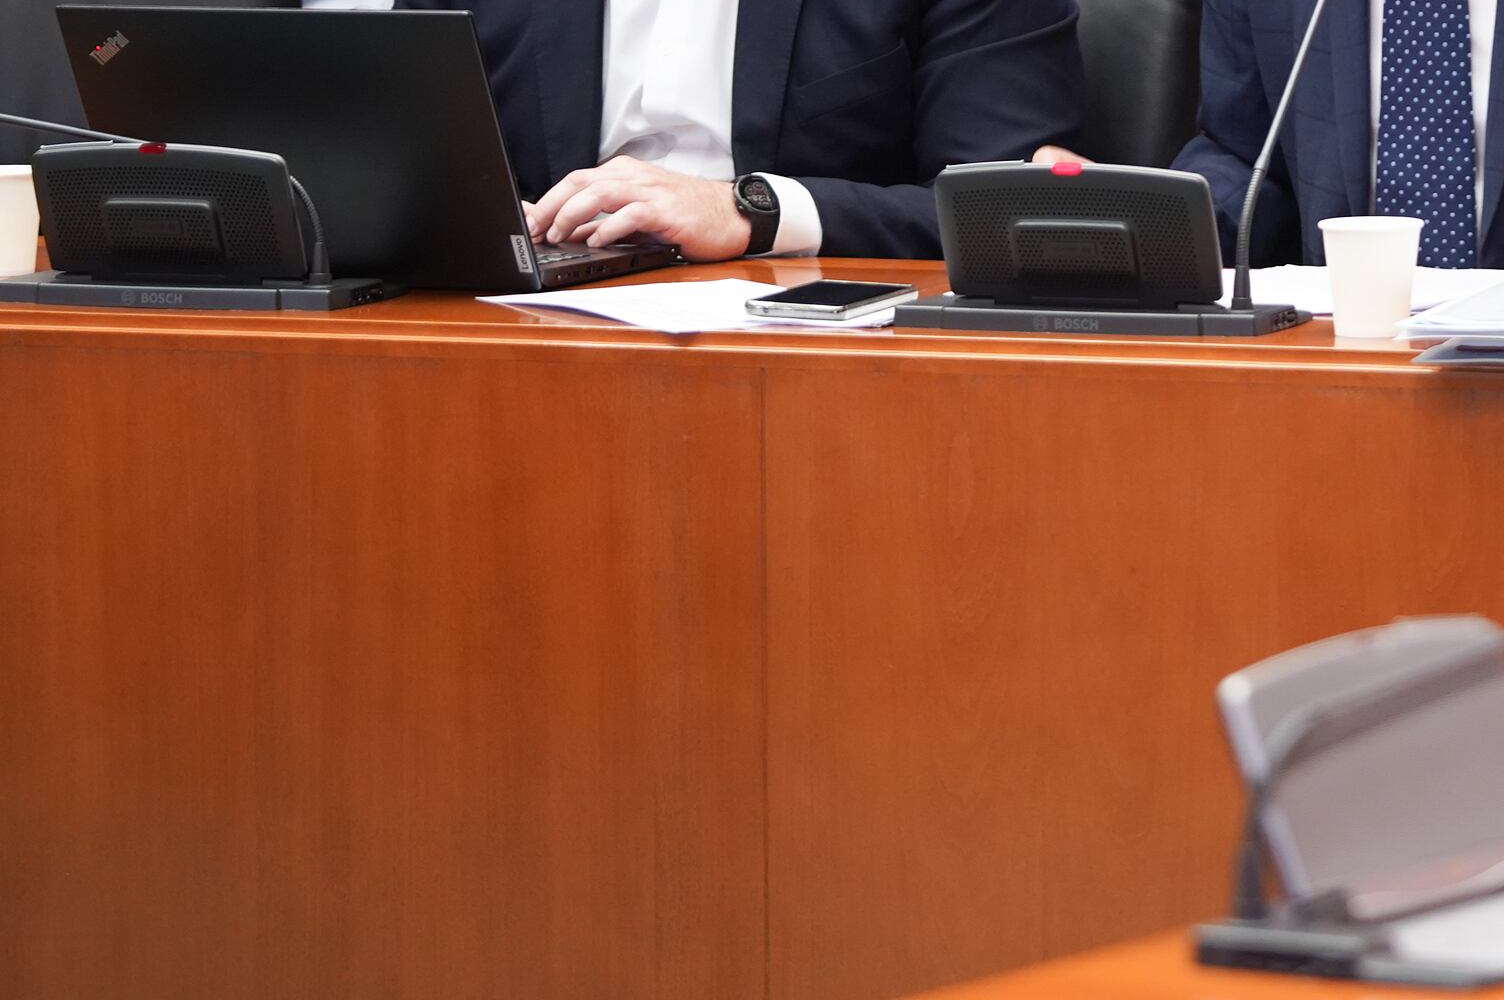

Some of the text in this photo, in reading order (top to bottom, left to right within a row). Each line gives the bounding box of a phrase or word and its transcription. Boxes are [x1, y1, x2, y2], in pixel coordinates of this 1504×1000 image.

[89, 30, 130, 66] ThinkPad
[516, 238, 529, 270] Lenovo
[140, 292, 183, 305] BOSCH
[1054, 318, 1100, 330] BOSCH
